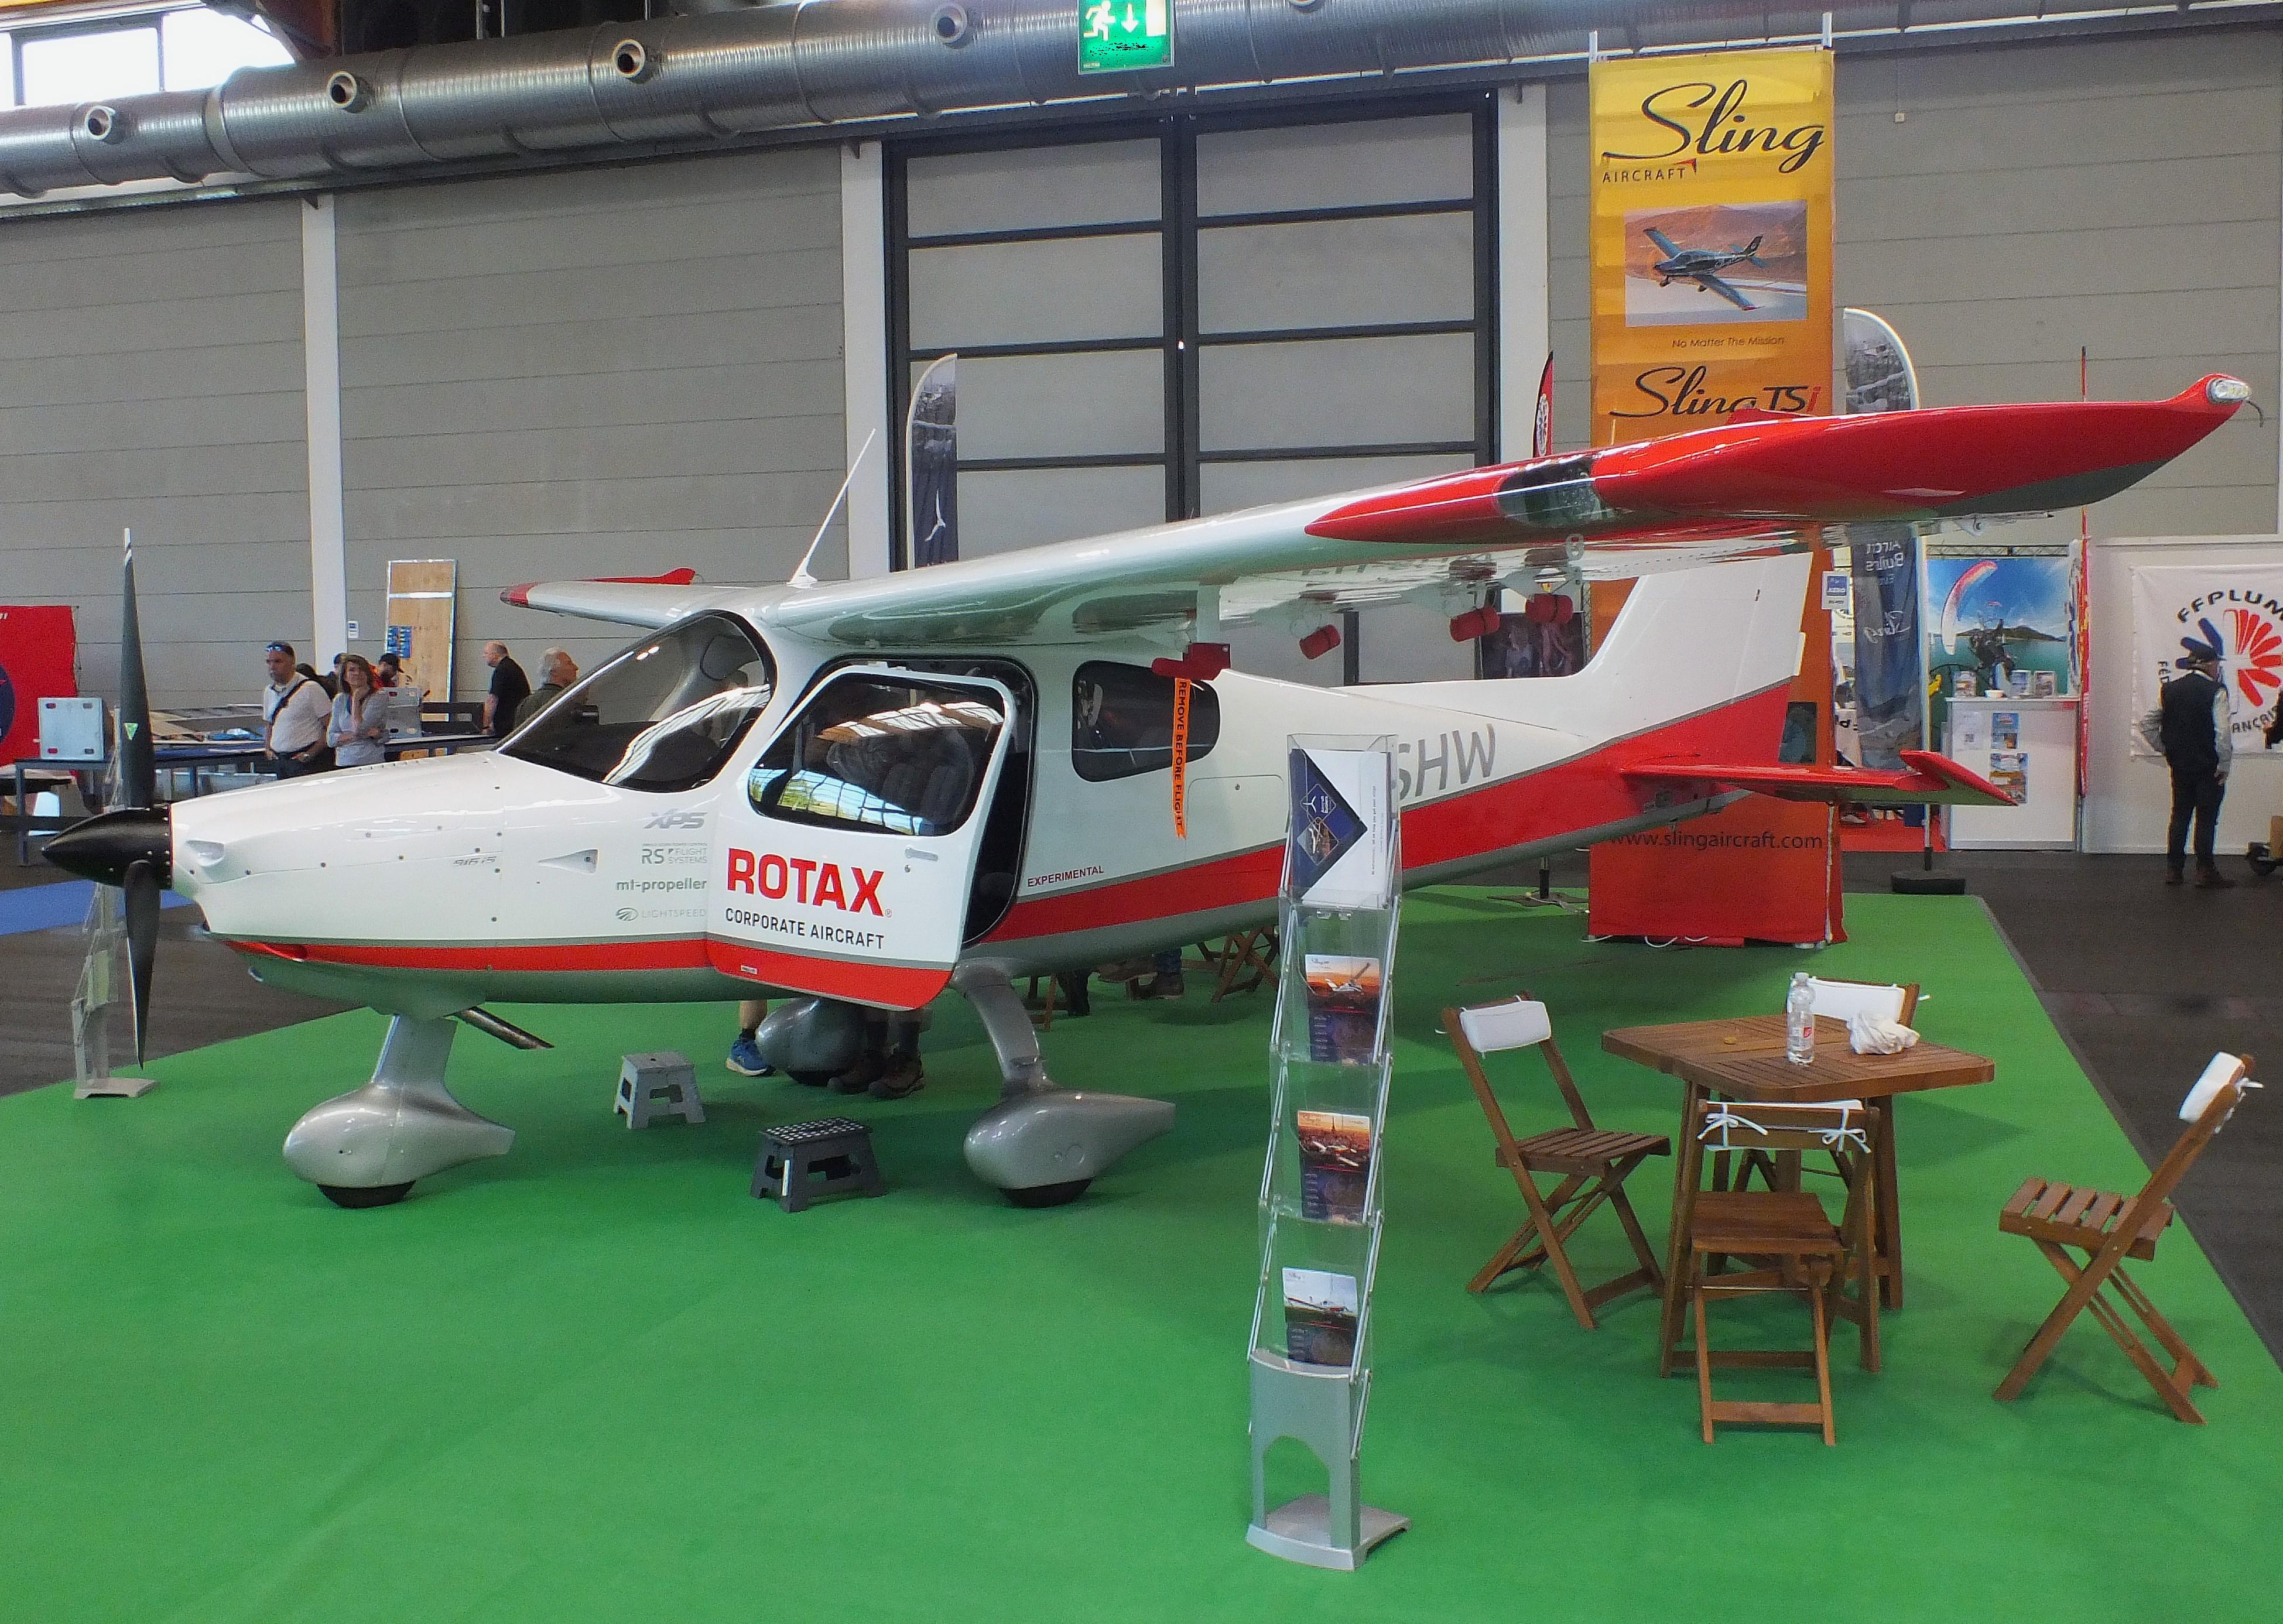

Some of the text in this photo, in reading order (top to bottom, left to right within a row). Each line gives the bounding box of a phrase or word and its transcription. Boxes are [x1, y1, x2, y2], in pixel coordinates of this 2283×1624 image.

[1602, 78, 1825, 173] Sling
[1602, 167, 1686, 184] AIRCRAFT
[1176, 681, 1187, 731] REMOVE
[1175, 734, 1184, 780] BEFORE
[644, 808, 708, 829] XPS
[641, 848, 665, 864] RS
[668, 856, 707, 864] SYSTEMS
[616, 877, 707, 893] mt-propeller
[727, 847, 884, 917] ROTAX
[1027, 865, 1105, 888] EXPERIMENTAL
[725, 907, 885, 950] CORPORATE AIRCRAFT
